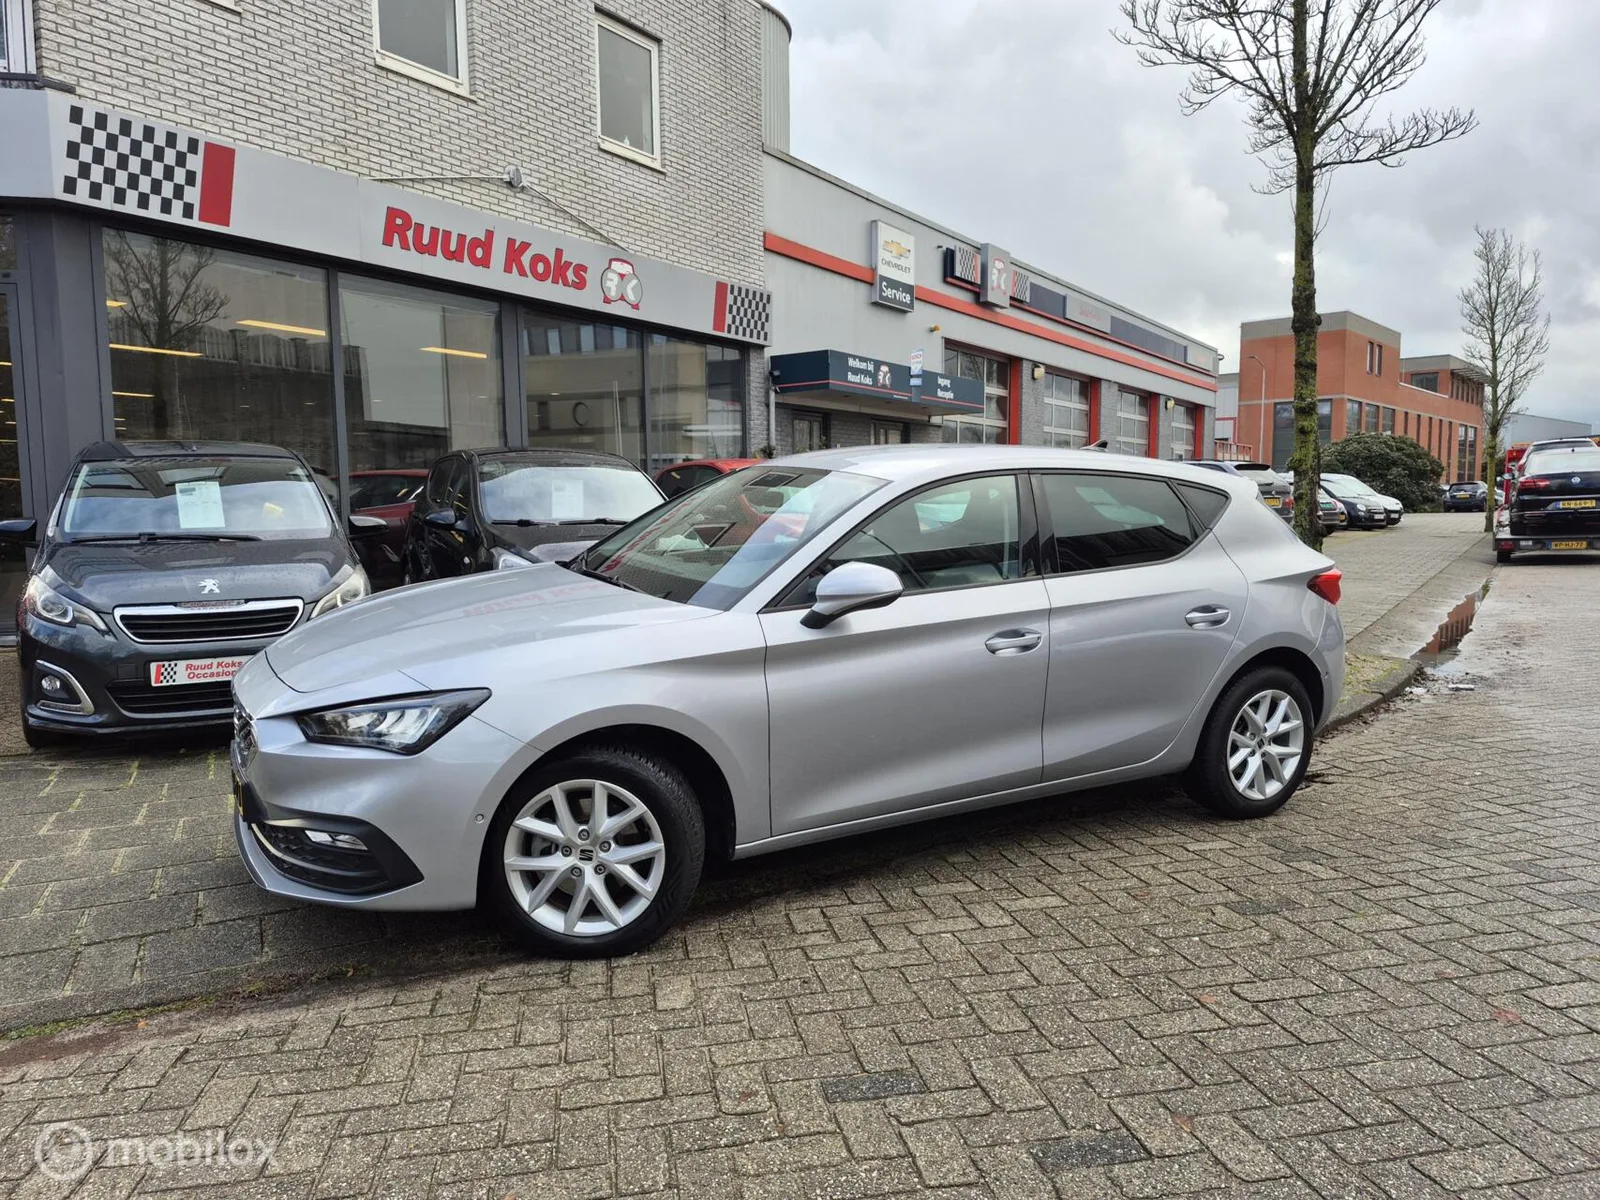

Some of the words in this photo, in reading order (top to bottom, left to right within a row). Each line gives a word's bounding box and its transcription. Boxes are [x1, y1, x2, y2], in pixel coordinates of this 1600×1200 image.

[382, 206, 495, 270] Ruud
[503, 237, 589, 291] Koks
[881, 257, 911, 275] CHEVROLET
[881, 280, 911, 304] Service
[848, 357, 867, 370] Welkom
[847, 371, 860, 383] Ruud
[861, 373, 873, 386] Koks
[185, 661, 213, 671] Ruud
[216, 660, 243, 670] Koks
